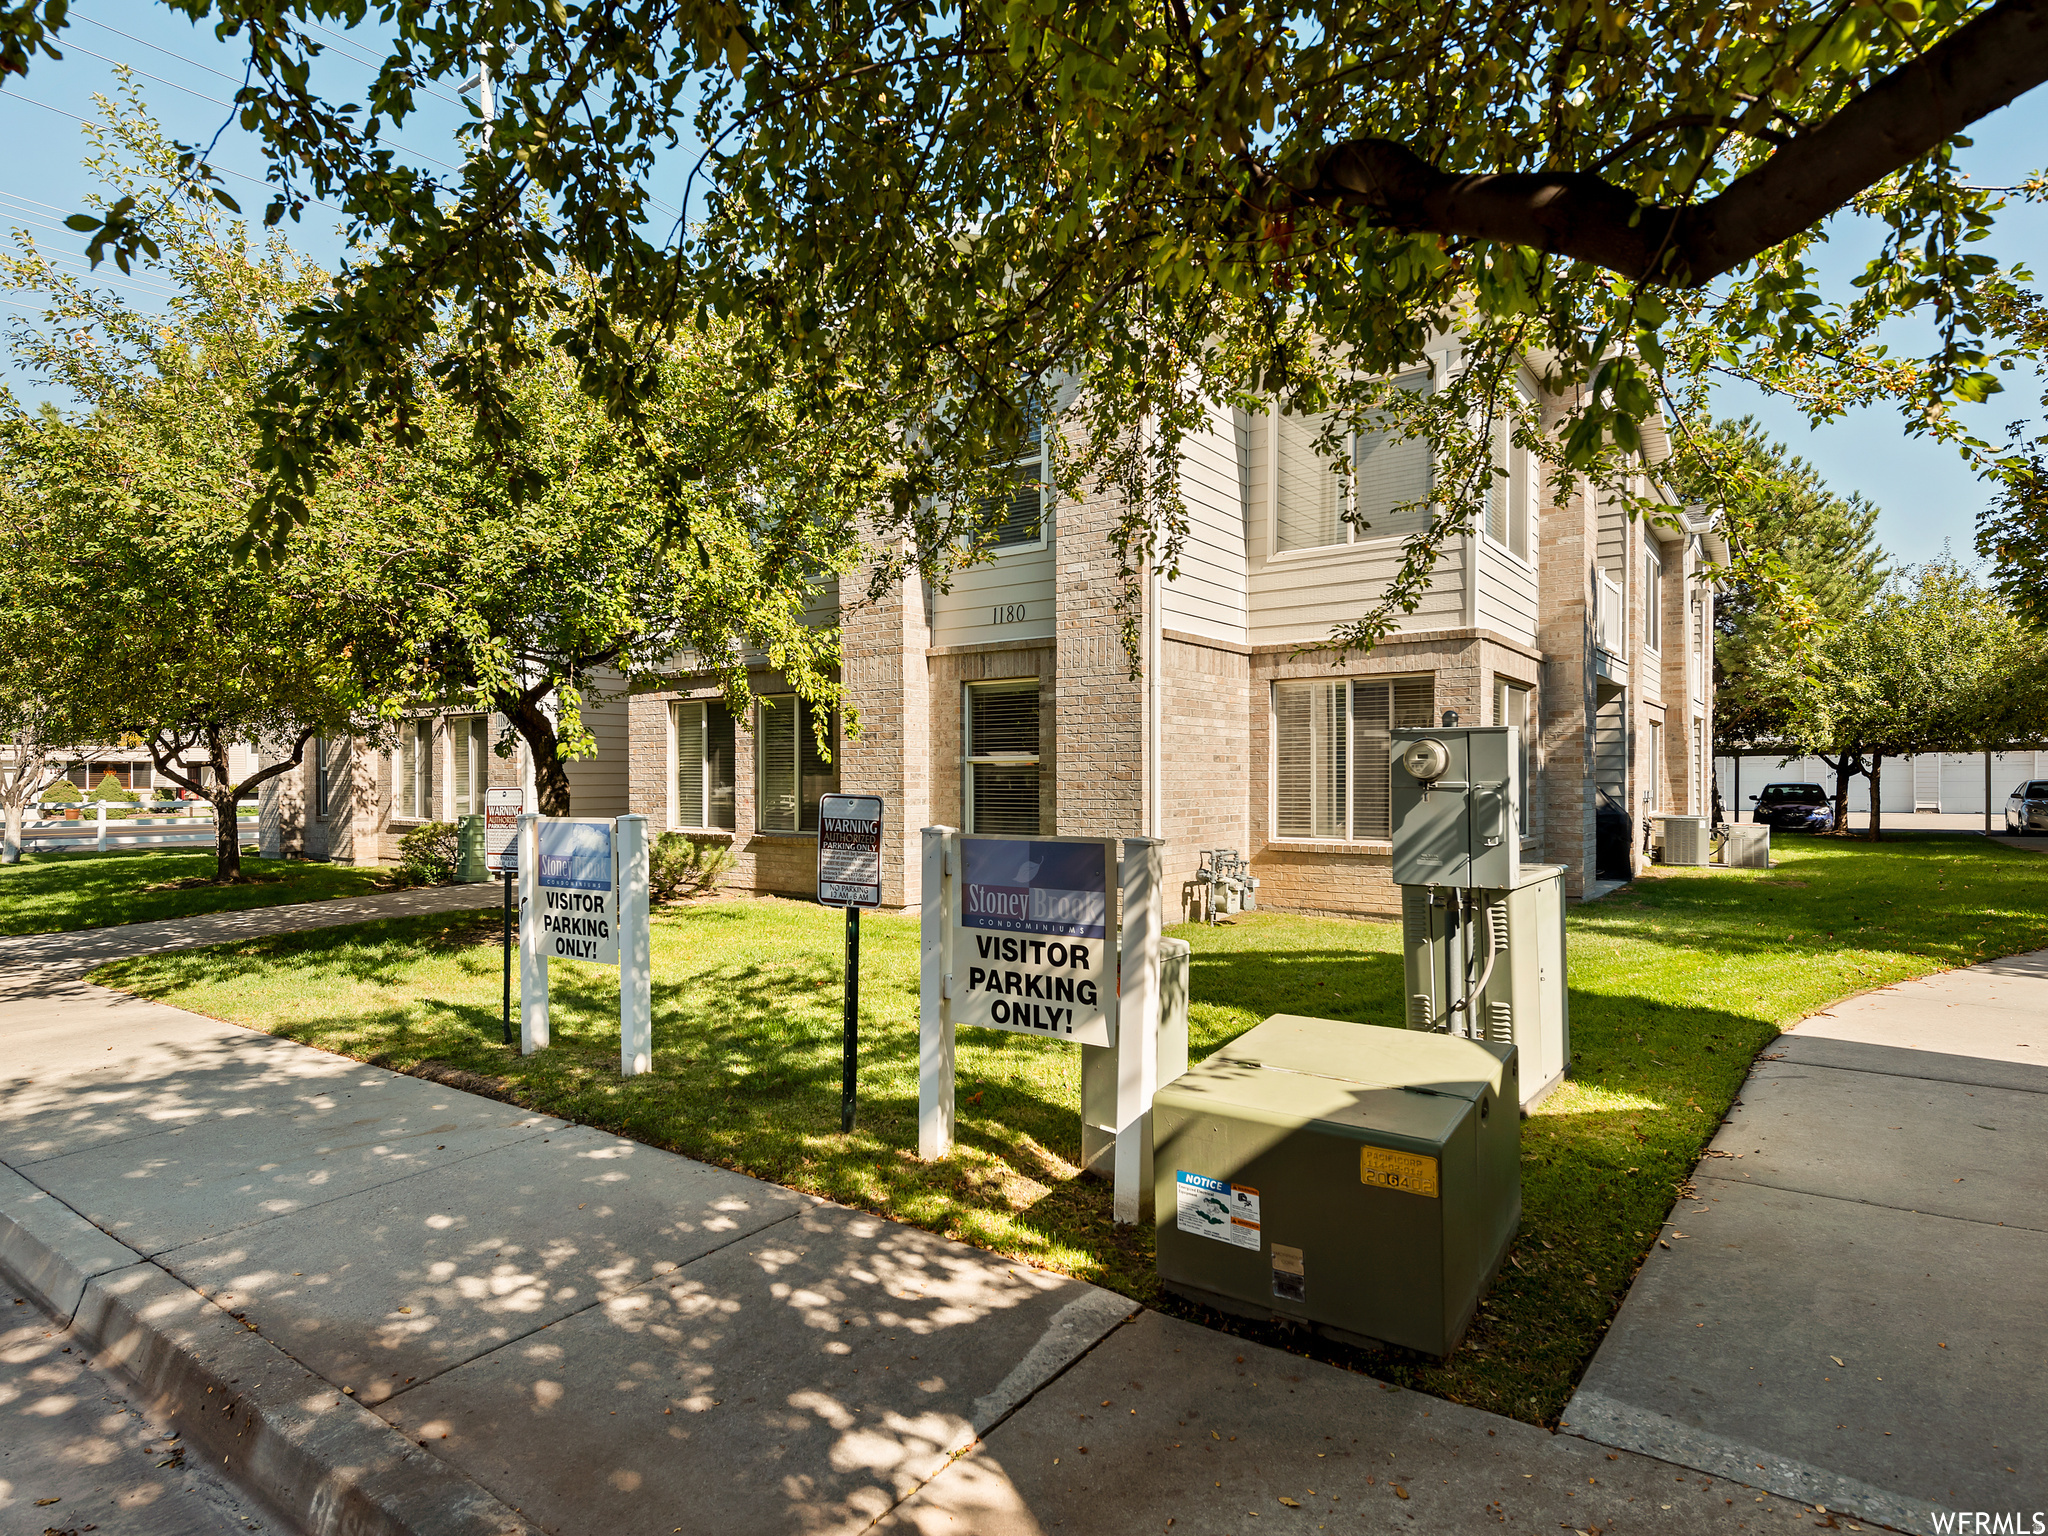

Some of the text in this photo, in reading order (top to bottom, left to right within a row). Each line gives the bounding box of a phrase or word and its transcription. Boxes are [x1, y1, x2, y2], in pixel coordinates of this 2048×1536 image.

[994, 604, 1025, 624] 1180
[488, 806, 521, 816] WARNING
[824, 819, 877, 834] WARNING
[823, 842, 877, 852] PARKING ONLY
[824, 832, 876, 844] AUTHORIZED
[542, 854, 608, 880] Stoney Brook
[546, 880, 601, 888] CONDOMINIUMS
[842, 885, 868, 894] PARKING
[546, 892, 604, 913] VISITOR
[969, 883, 1098, 922] Stoney Brook
[544, 915, 609, 939] PARKING
[979, 918, 1085, 935] CONDOMINIUMS
[556, 937, 597, 959] ONLY!
[976, 934, 1090, 970] VISITOR
[969, 966, 1098, 1006] PARKING
[991, 1000, 1073, 1034] ONLY!
[1366, 1152, 1422, 1167] PACIFICORP
[1186, 1174, 1223, 1191] NOTICE
